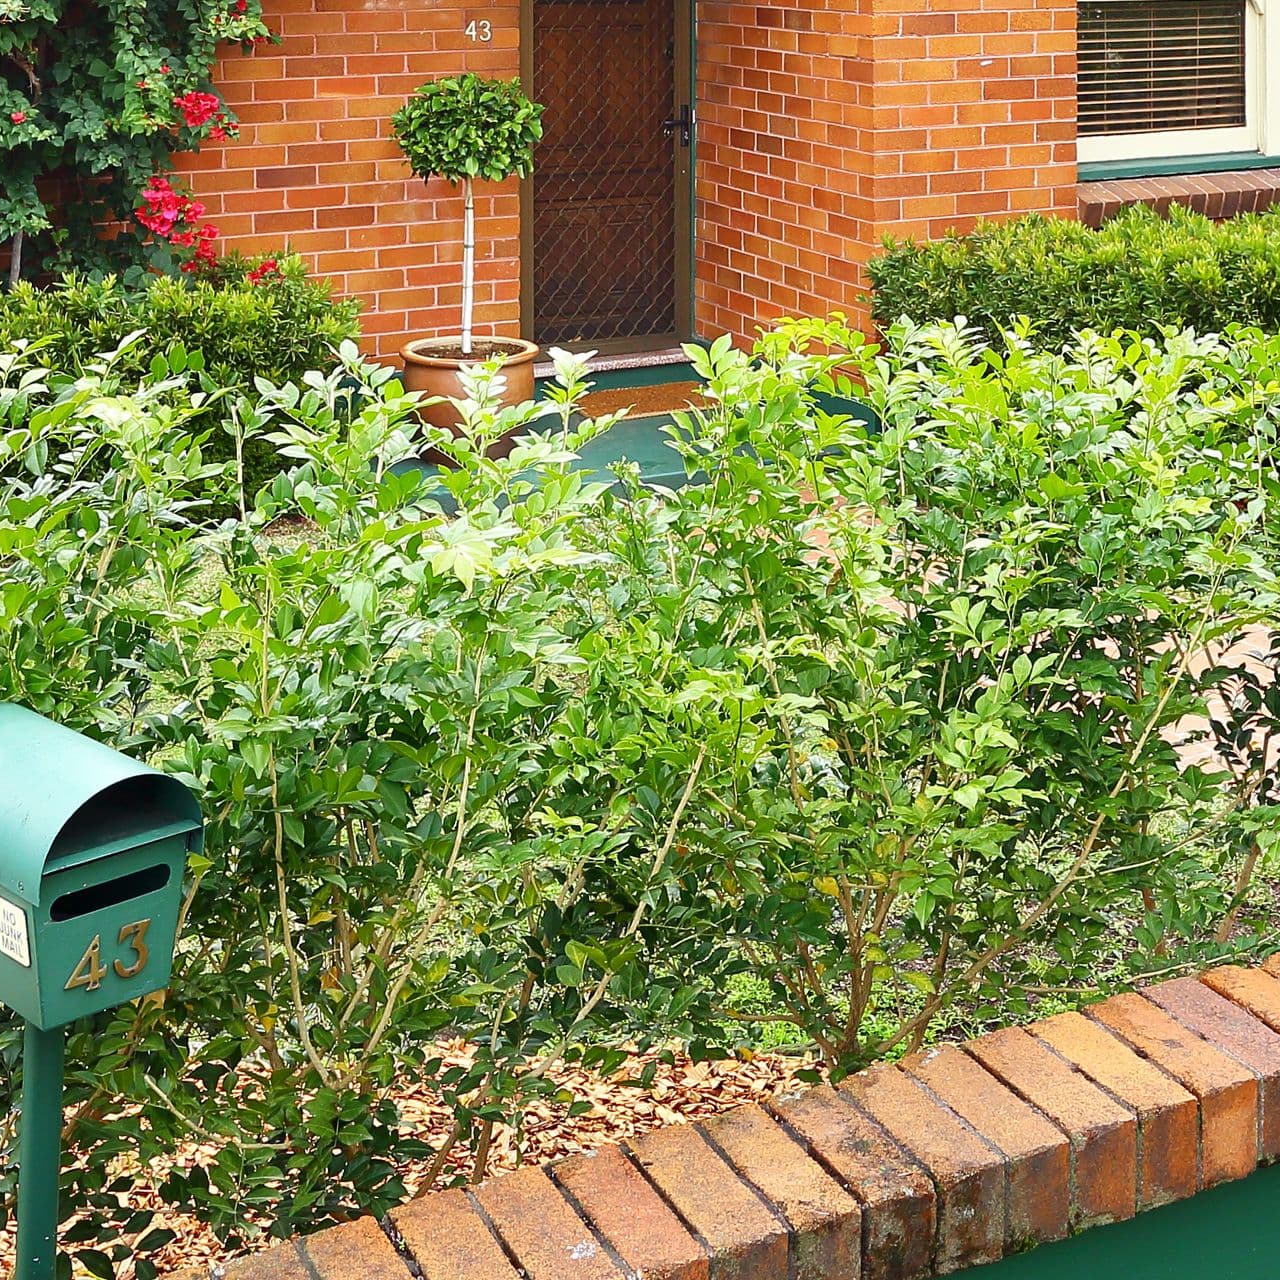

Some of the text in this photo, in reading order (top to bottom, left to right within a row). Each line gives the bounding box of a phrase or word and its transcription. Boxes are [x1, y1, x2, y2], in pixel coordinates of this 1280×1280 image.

[464, 19, 492, 42] 43
[3, 909, 17, 926] NO
[0, 922, 23, 944] JUNK
[1, 935, 25, 959] MAIL
[63, 918, 151, 992] 43
